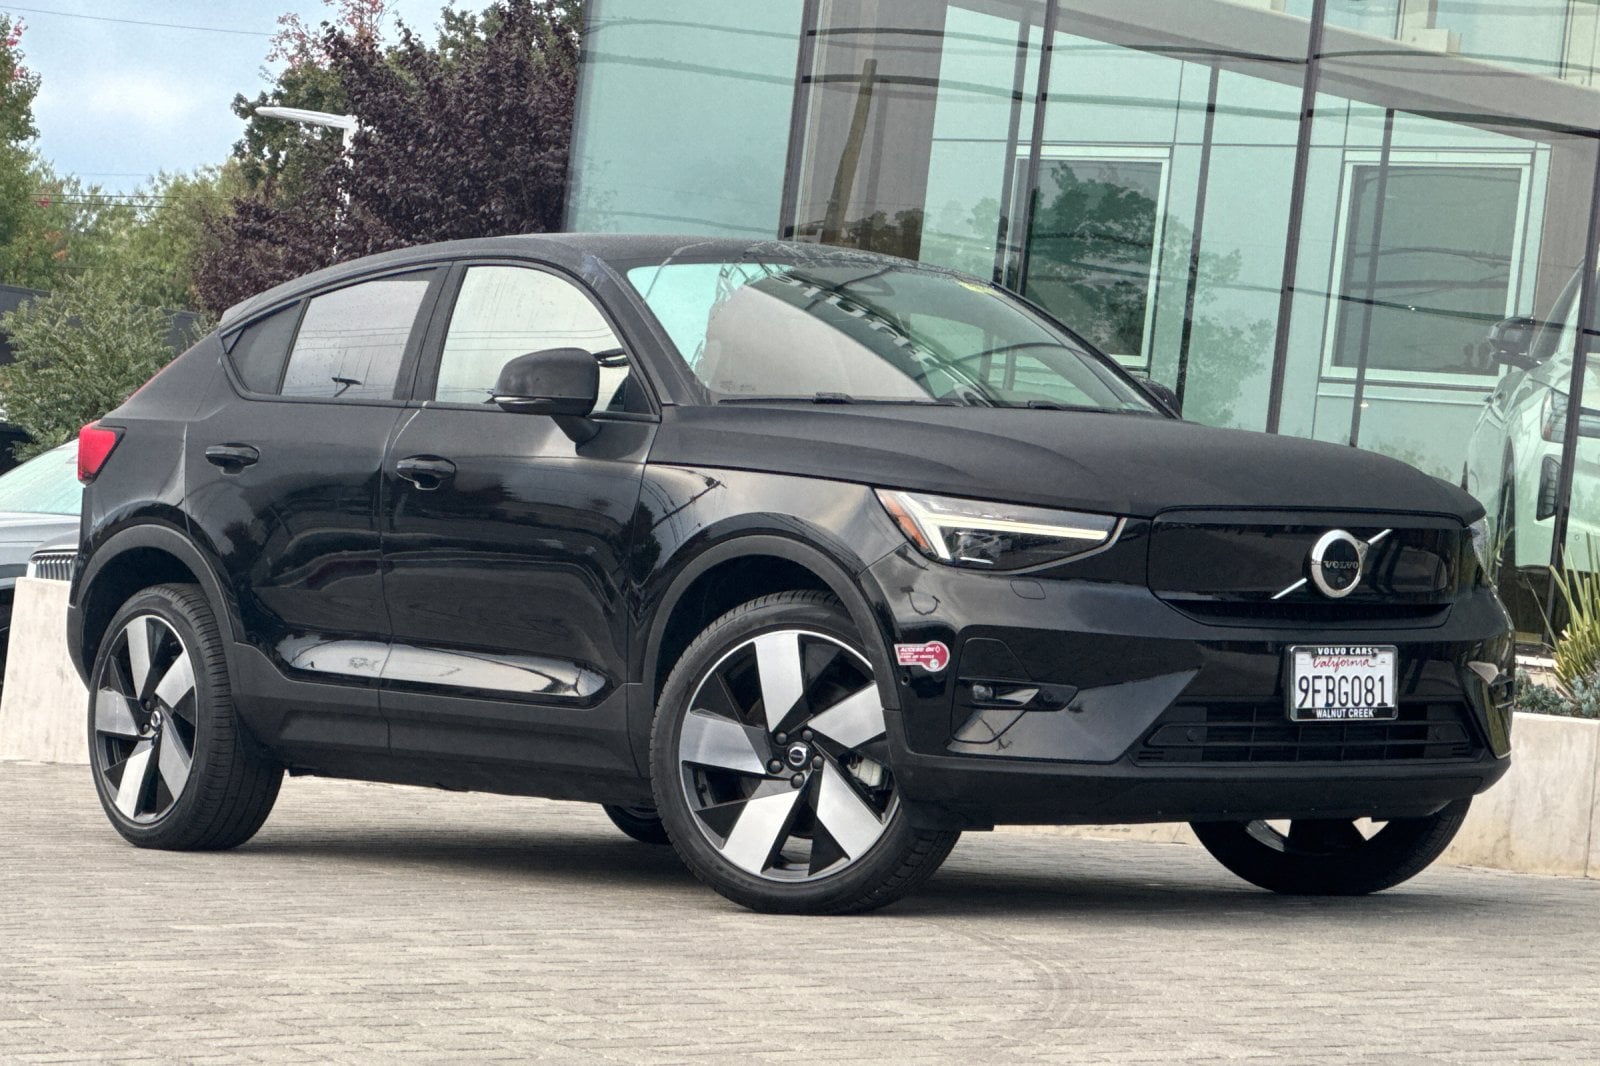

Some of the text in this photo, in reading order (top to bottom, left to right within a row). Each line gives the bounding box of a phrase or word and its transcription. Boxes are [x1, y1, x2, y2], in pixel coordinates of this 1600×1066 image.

[1323, 560, 1359, 569] VOLVO
[1317, 647, 1373, 655] VOLVO CARS
[1313, 656, 1376, 673] California
[1298, 675, 1388, 708] 9FBG081
[1316, 709, 1374, 718] WALNUT CREEK
